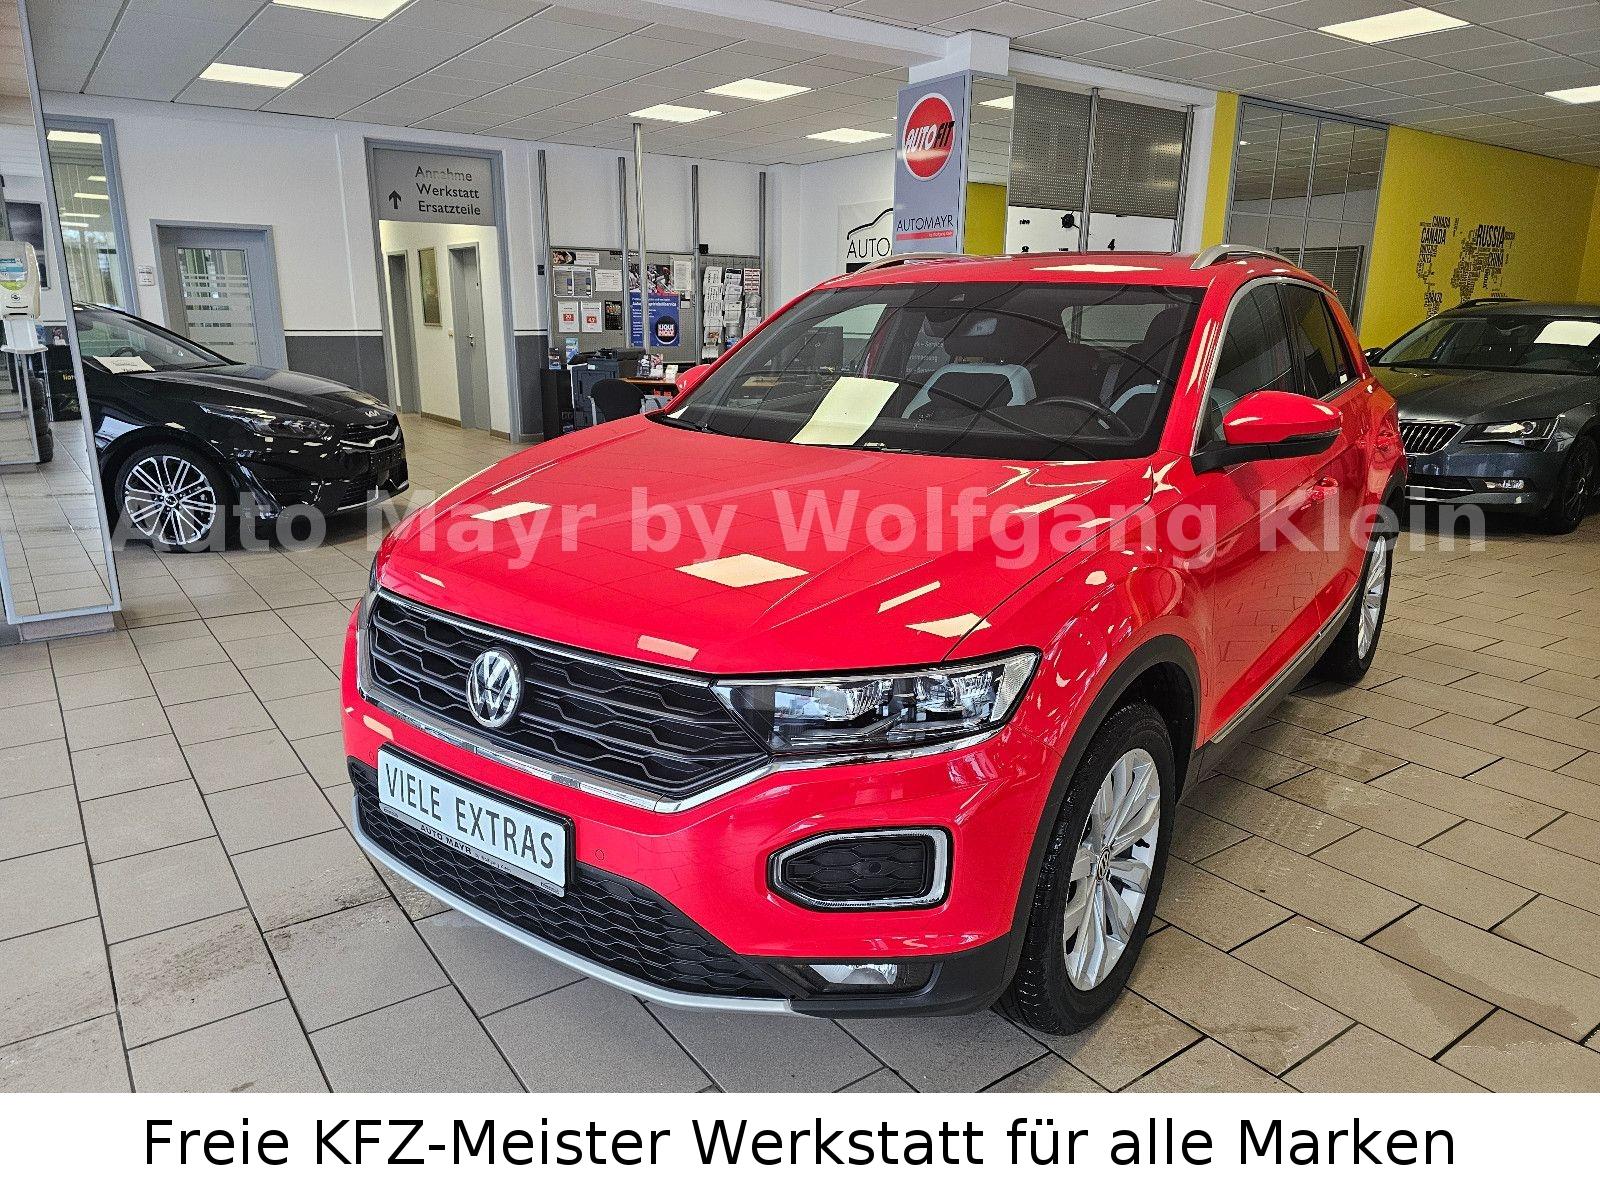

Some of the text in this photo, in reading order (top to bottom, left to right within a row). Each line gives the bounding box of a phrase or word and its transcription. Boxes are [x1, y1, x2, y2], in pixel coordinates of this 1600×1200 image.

[905, 120, 955, 153] AUTOFIT
[416, 182, 480, 199] Werkstatt
[418, 200, 481, 215] Ersatzteile
[896, 214, 954, 232] AUTOMAYR
[1108, 238, 1115, 250] 4
[1420, 227, 1447, 246] CANADA
[1476, 224, 1506, 248] RUSSIA
[847, 237, 892, 258] AUTO
[385, 763, 554, 870] VIELE EXTRAS
[420, 824, 472, 855] AUTO MAYR
